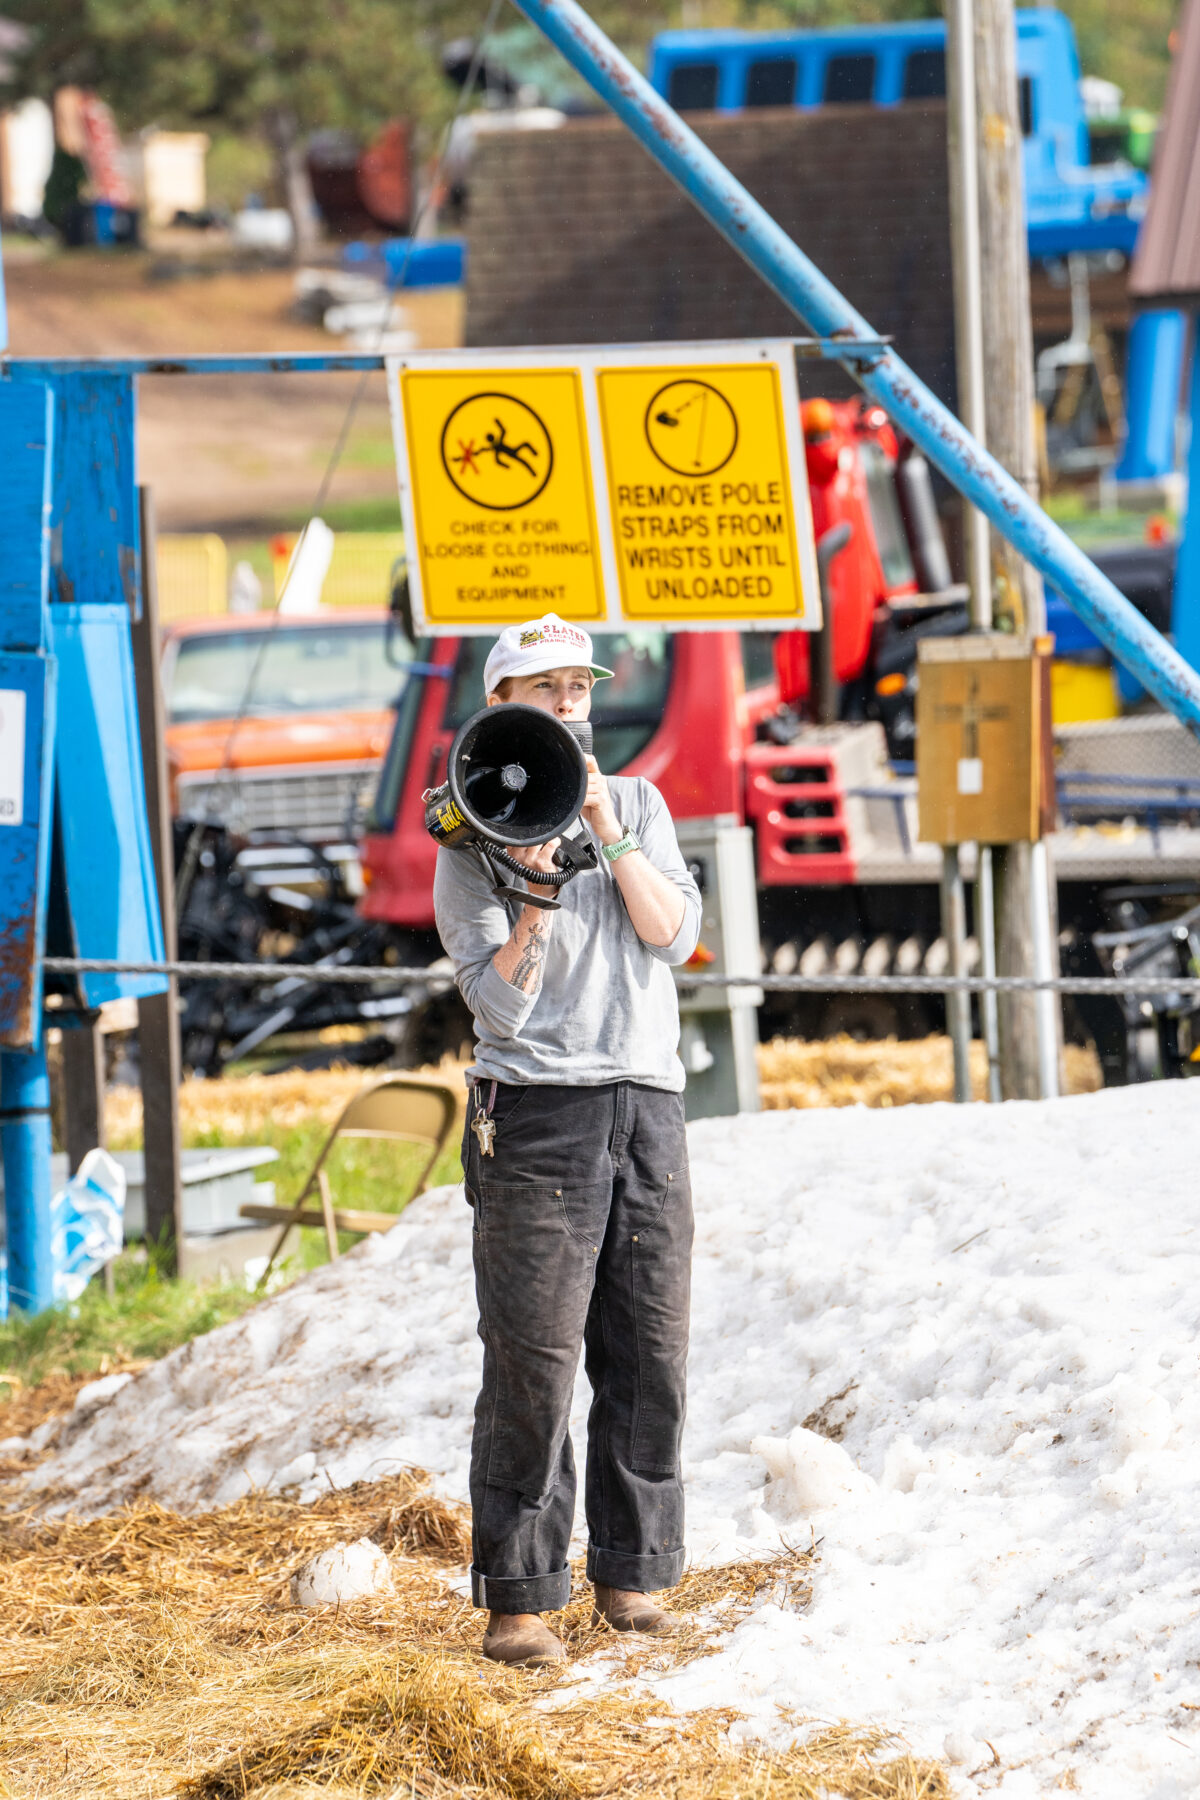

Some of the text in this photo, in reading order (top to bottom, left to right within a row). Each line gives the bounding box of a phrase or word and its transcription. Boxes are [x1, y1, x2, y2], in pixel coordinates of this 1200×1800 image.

[618, 482, 780, 507] REMOVE POLE
[450, 520, 560, 536] CHECK FOR
[621, 514, 783, 538] STRAPS FROM
[424, 541, 590, 559] LOOSE CLOTHING
[626, 545, 786, 569] WRISTS UNTIL
[491, 565, 530, 578] AND
[456, 586, 565, 602] EQUIPMENT
[646, 576, 773, 600] UNLOADED
[543, 624, 586, 643] SLATER
